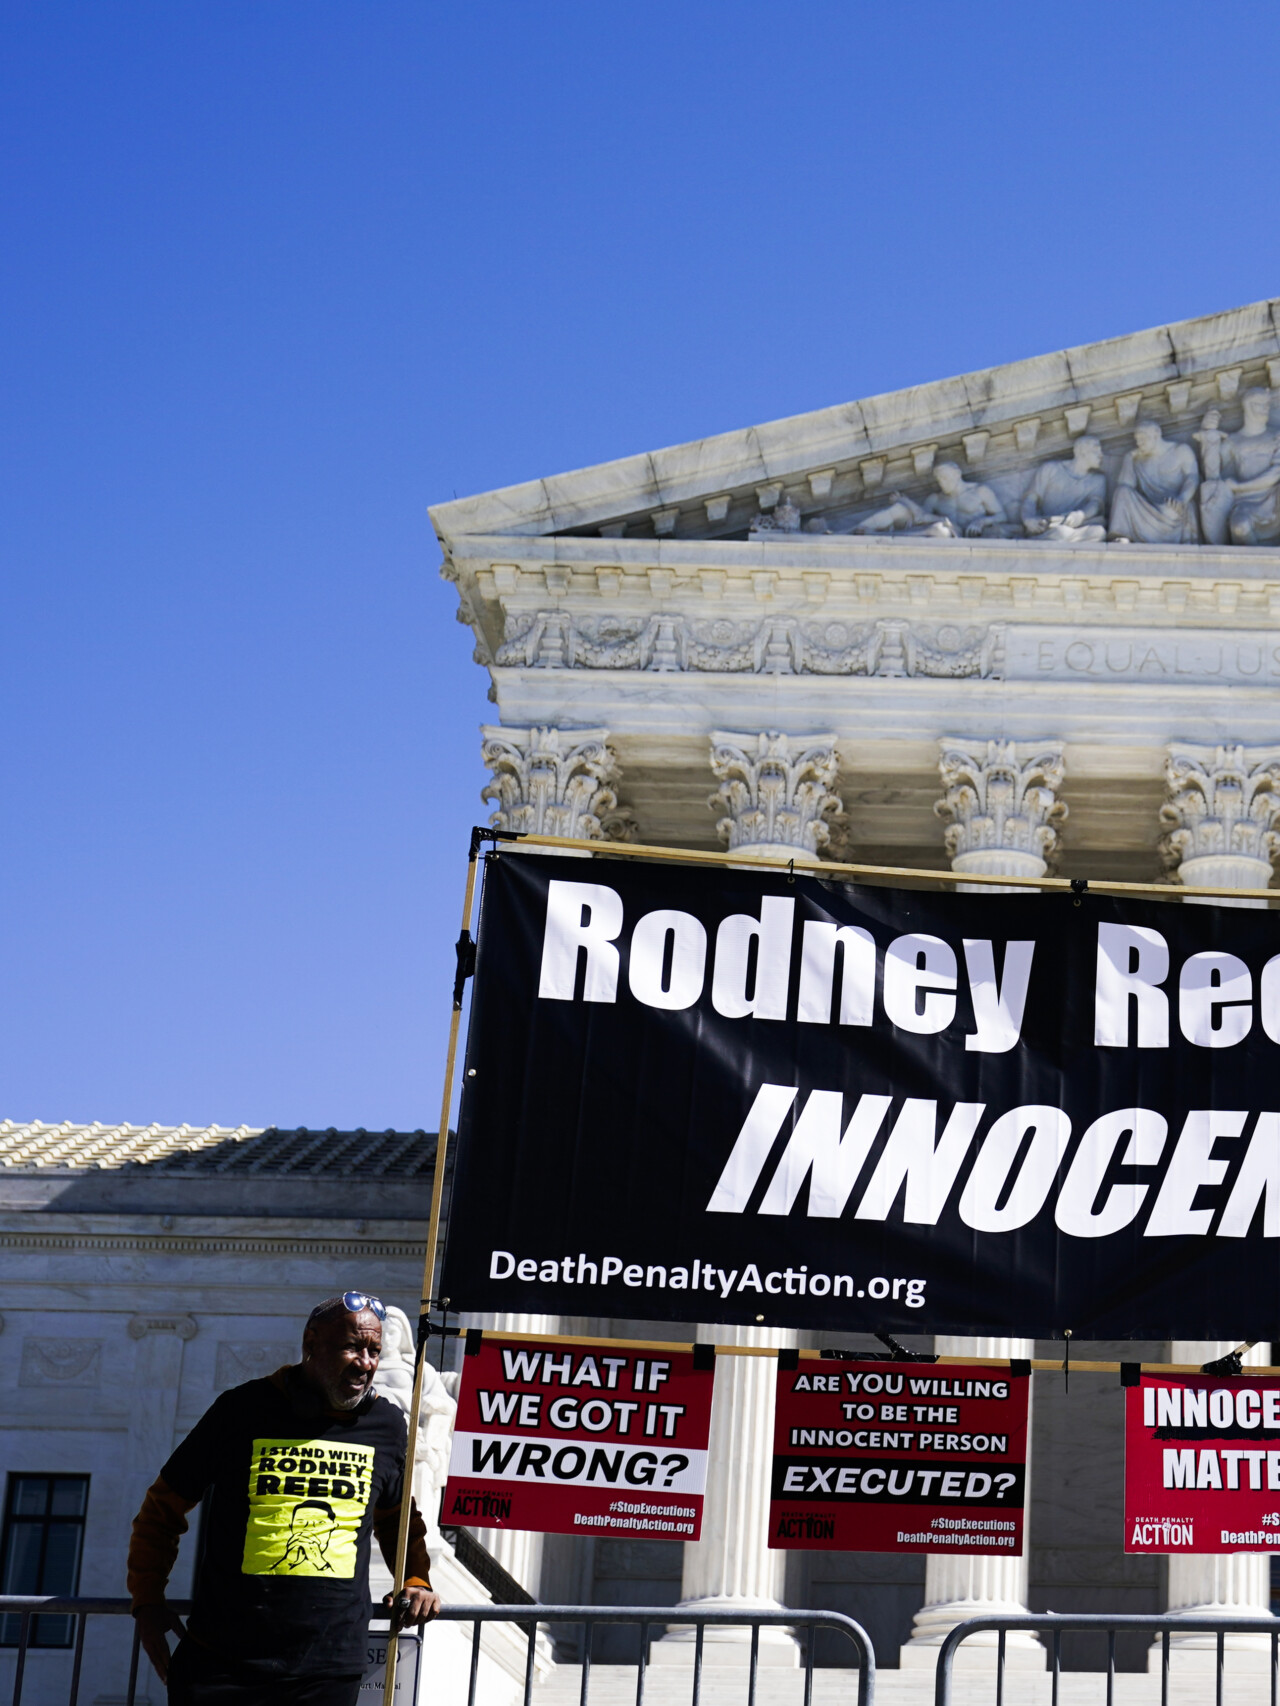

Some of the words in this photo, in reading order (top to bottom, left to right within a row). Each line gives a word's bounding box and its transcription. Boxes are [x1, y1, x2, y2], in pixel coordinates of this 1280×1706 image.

[1037, 640, 1192, 676] EQUAL
[538, 878, 1036, 1054] Rodney
[488, 1249, 927, 1309] DeathPenaltyAction.org
[502, 1349, 627, 1389] WHAT
[633, 1360, 670, 1392] IF
[795, 1375, 840, 1392] ARE
[846, 1373, 904, 1395] YOU
[910, 1379, 1008, 1398] WILLING
[479, 1390, 541, 1426] WE
[549, 1397, 638, 1433] GOT
[645, 1404, 684, 1437] IT
[842, 1403, 875, 1420] TO
[881, 1405, 908, 1421] BE
[913, 1406, 958, 1423] THE
[792, 1429, 914, 1449] INNOCENT
[919, 1433, 1007, 1452] PERSON
[259, 1446, 267, 1457] I
[269, 1446, 325, 1459] STAND
[328, 1449, 367, 1463] WITH
[472, 1438, 690, 1488] WRONG?
[258, 1457, 367, 1479] RODNEY
[255, 1474, 366, 1503] REED!
[782, 1465, 1016, 1499] EXECUTED?
[451, 1496, 513, 1518] ACTION
[609, 1500, 696, 1519] #StopExecutions
[573, 1512, 695, 1534] DeathPenaltyAction.org
[776, 1517, 835, 1539] ACTION
[930, 1517, 1016, 1532] #StopExecutions
[1131, 1522, 1194, 1546] ACTION
[896, 1531, 1015, 1548] DeathPenaltyAction.org
